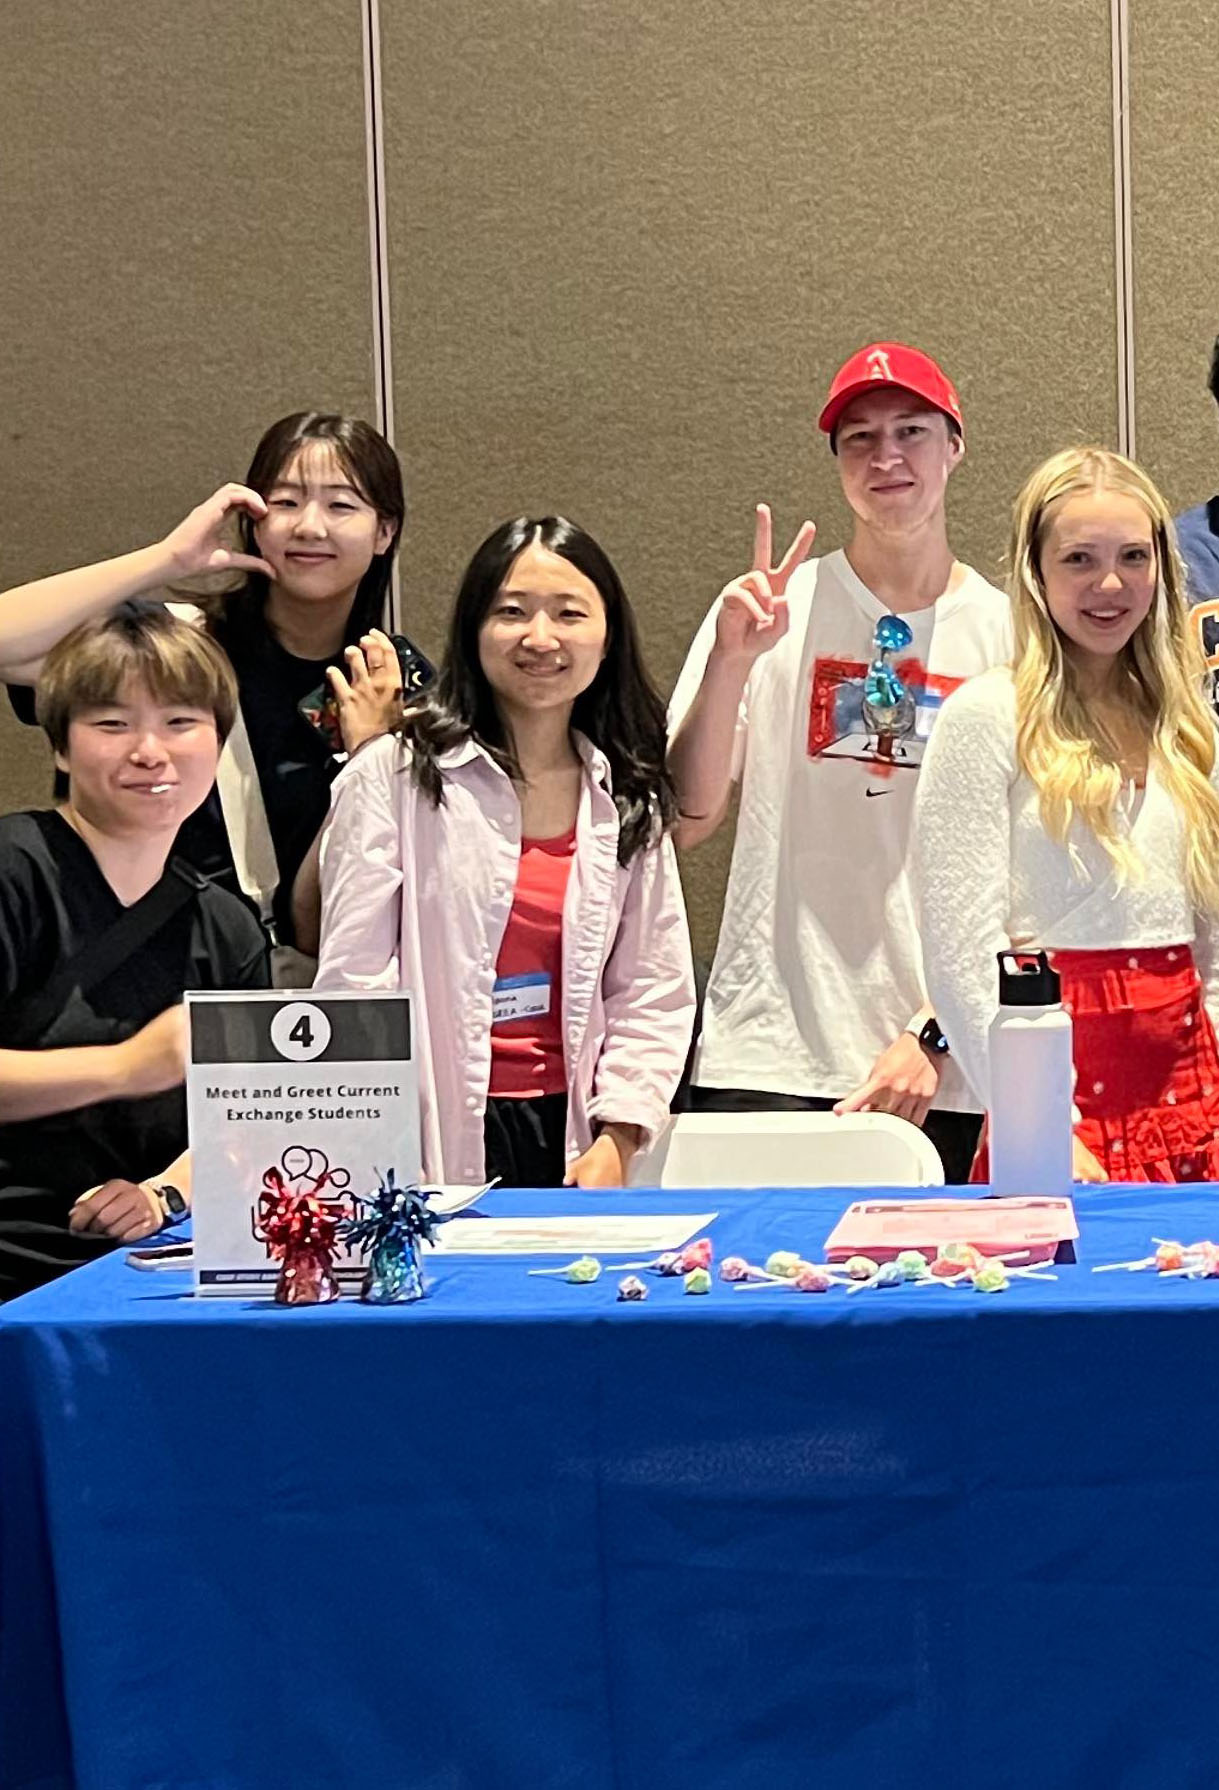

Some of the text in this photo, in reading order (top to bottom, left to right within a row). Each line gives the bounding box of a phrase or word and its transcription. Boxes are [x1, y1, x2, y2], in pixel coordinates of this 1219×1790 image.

[289, 1015, 314, 1048] 4
[206, 1084, 400, 1099] Meet and Greet Current
[226, 1107, 381, 1123] Exchange Students
